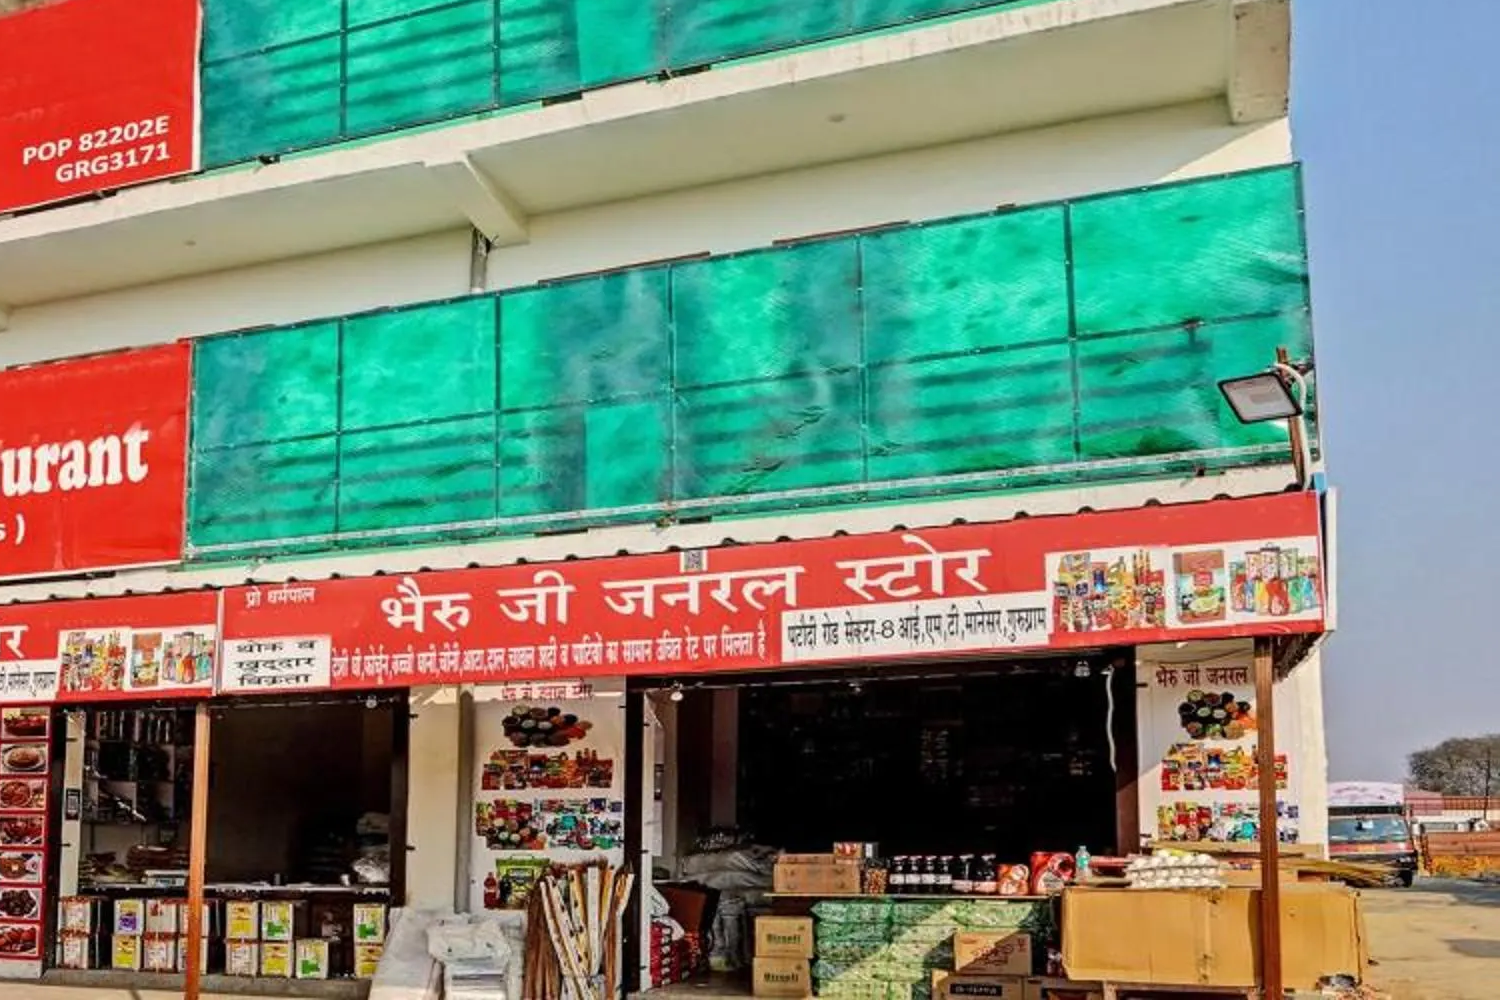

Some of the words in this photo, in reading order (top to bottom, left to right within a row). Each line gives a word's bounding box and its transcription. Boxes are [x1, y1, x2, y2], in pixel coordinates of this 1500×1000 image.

[23, 138, 72, 164] POP
[79, 115, 170, 152] 82202E
[55, 141, 170, 182] GRG3171
[497, 569, 576, 625] जी
[601, 565, 805, 618] जनरल
[835, 534, 992, 601] स्टोर
